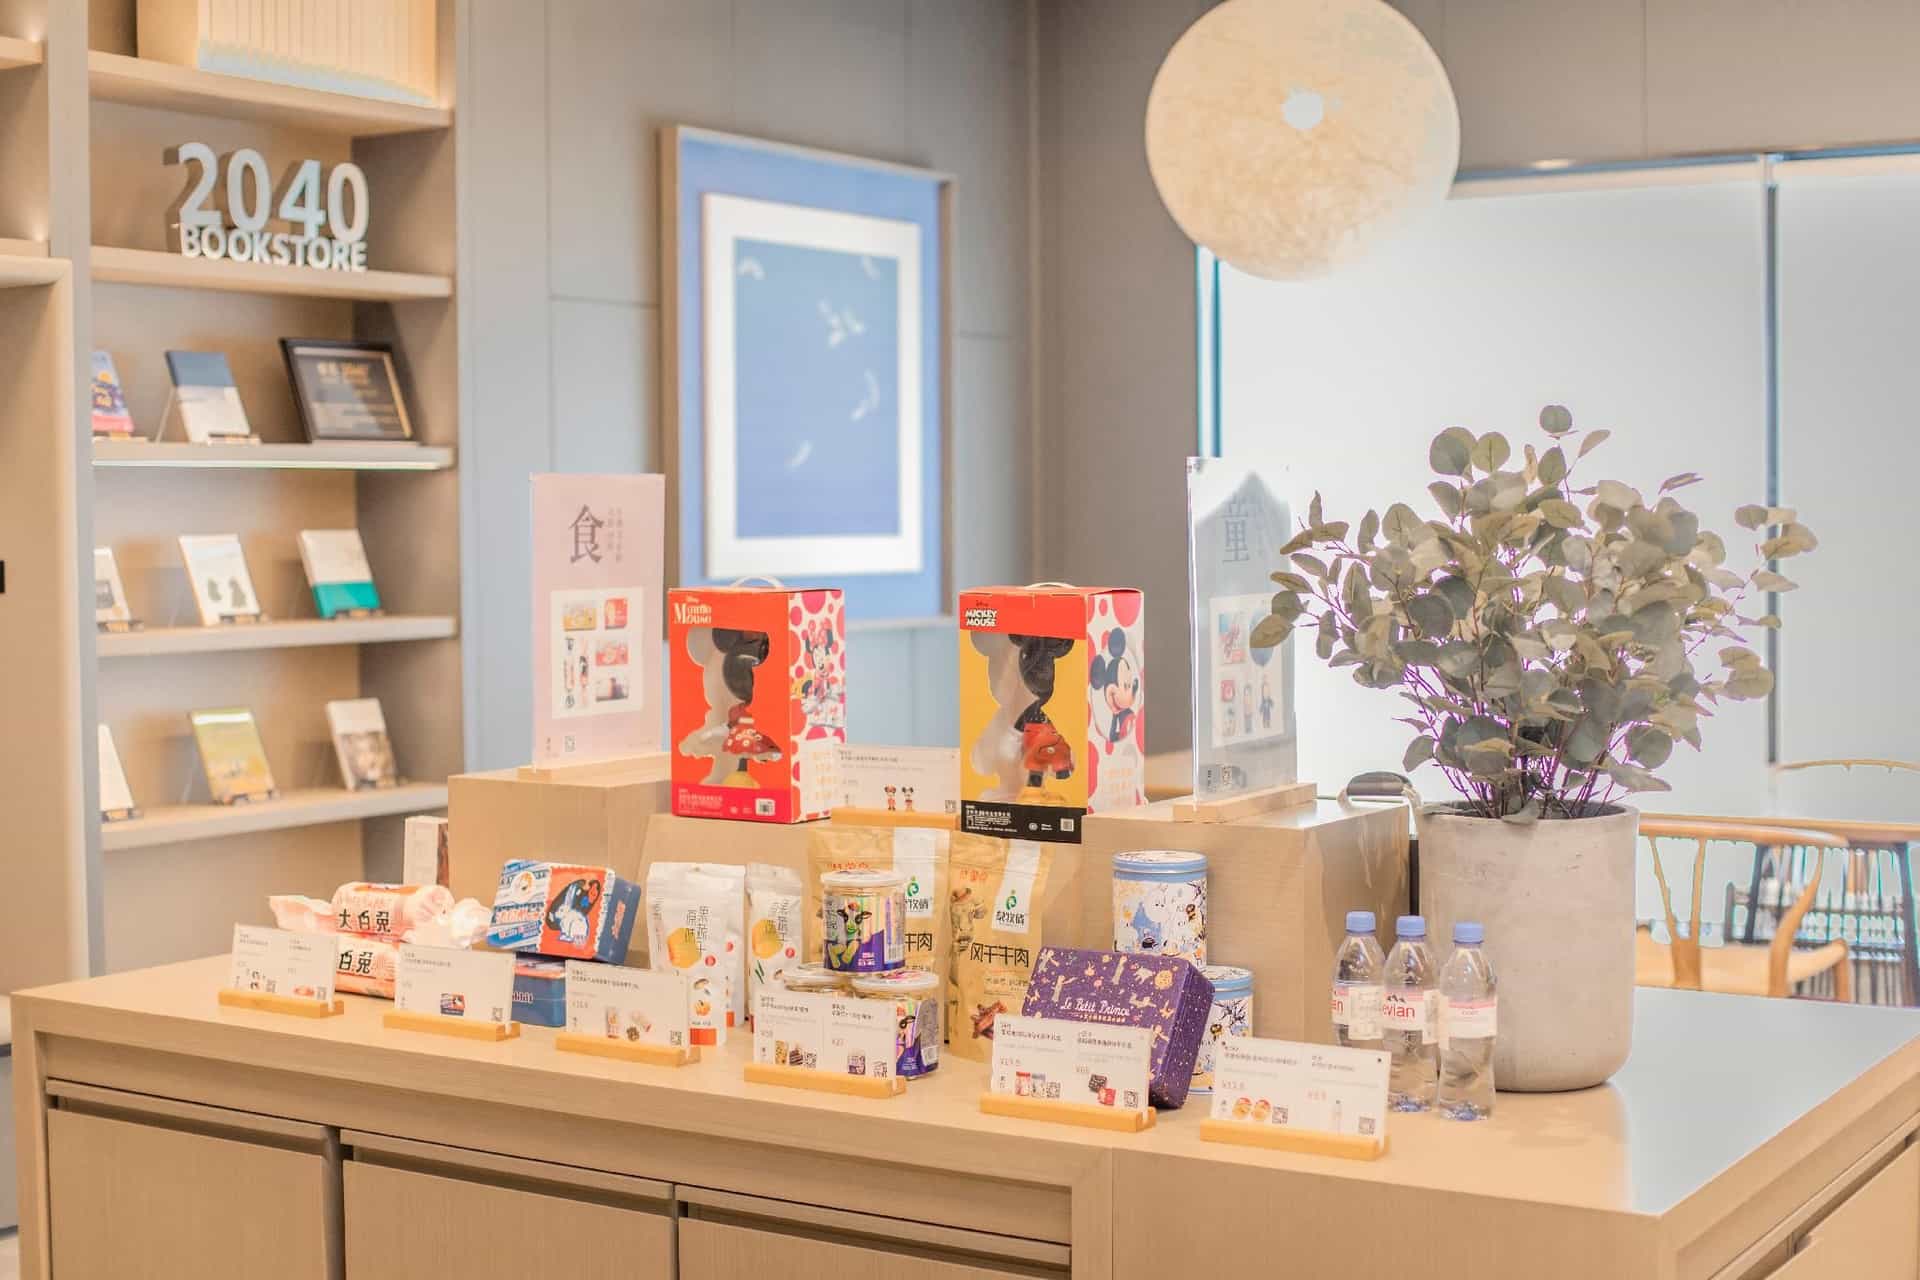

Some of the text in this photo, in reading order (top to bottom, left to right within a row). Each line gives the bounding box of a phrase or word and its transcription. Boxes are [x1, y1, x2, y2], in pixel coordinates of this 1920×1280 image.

[178, 142, 369, 242] 2040
[179, 223, 368, 272] BOOKSTORE
[568, 504, 604, 563] 食
[965, 608, 998, 618] MICKEY
[966, 618, 997, 627] MOUSE
[339, 908, 391, 933] 大白兔
[970, 942, 1029, 968] 风干牛肉
[1061, 997, 1131, 1016] Le Petit Prince
